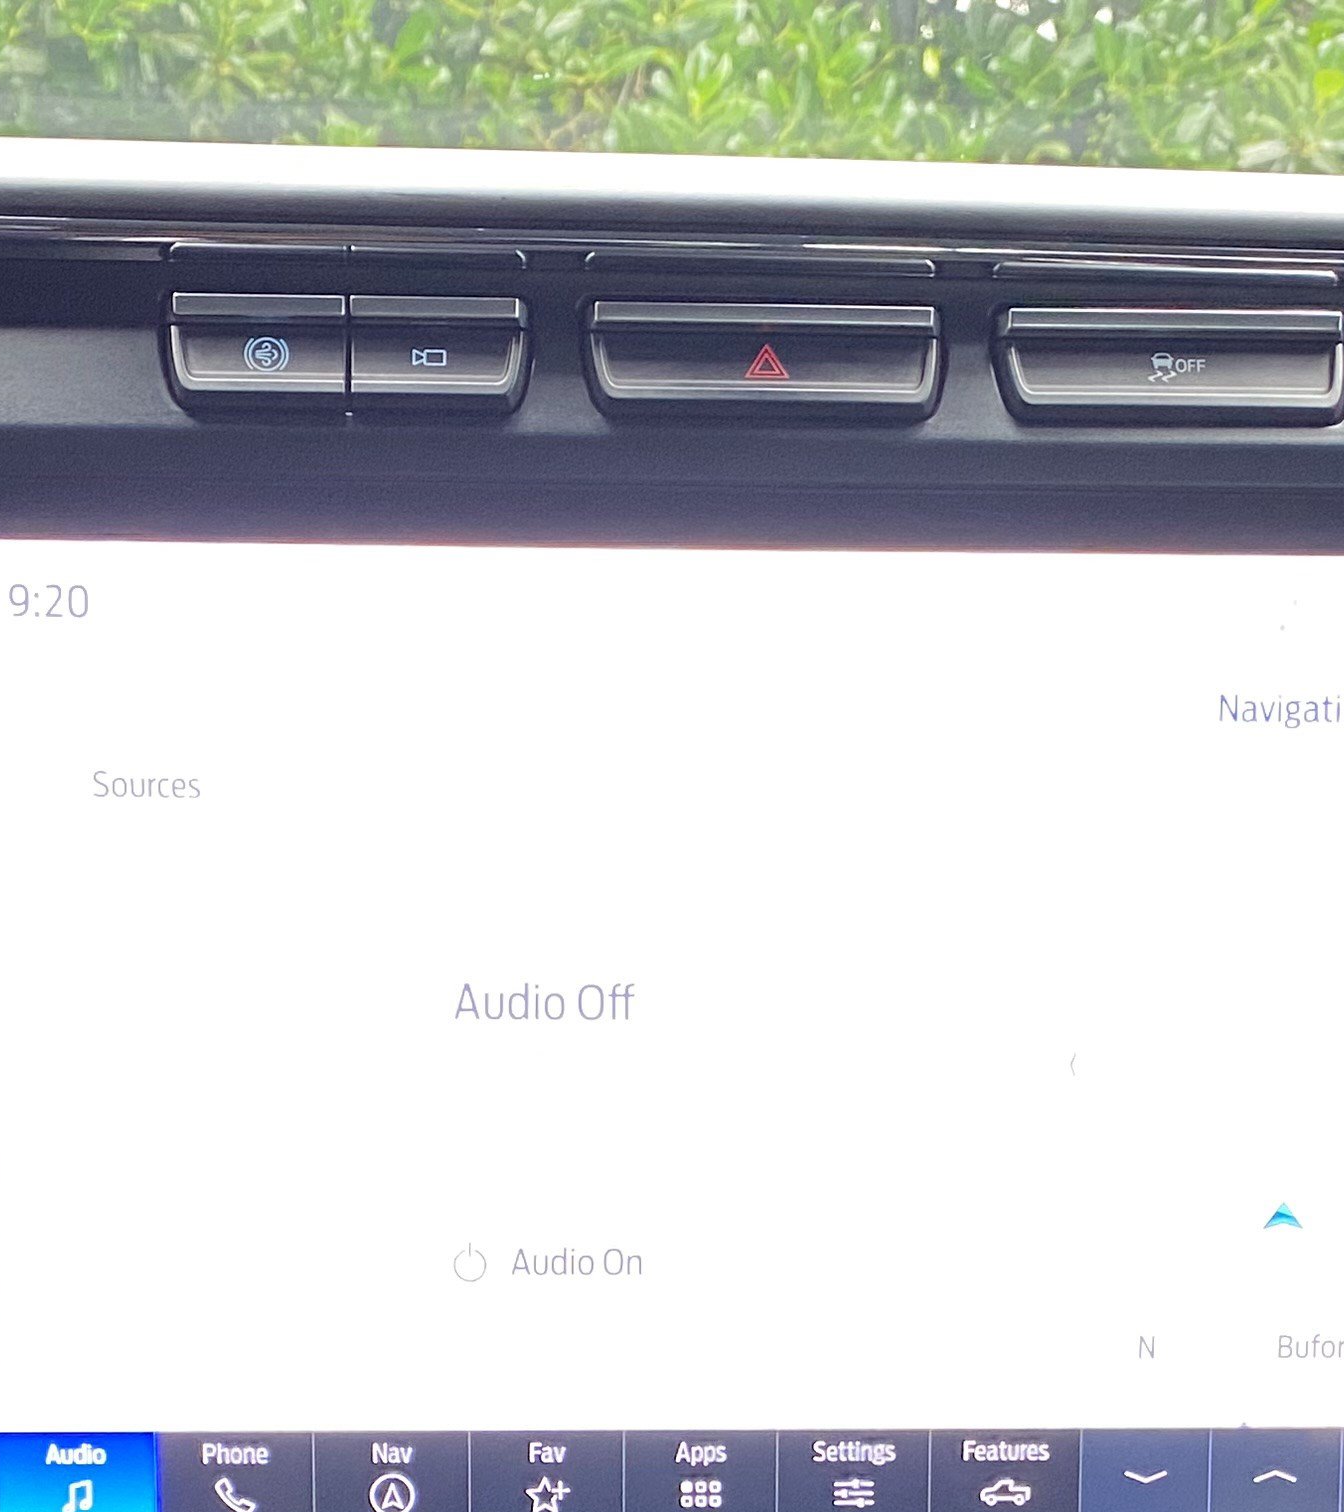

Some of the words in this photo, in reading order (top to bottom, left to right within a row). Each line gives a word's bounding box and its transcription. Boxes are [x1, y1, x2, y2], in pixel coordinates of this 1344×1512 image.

[1174, 357, 1207, 374] OFF
[8, 583, 89, 619] 9:20
[92, 770, 201, 799] Sources
[454, 983, 565, 1021] Audio
[577, 983, 636, 1021] Off
[511, 1246, 595, 1276] Audio
[603, 1247, 643, 1276] On
[1138, 1335, 1156, 1360] N
[45, 1442, 107, 1465] Audio
[202, 1442, 269, 1465] Phone
[372, 1442, 413, 1464] Nav
[528, 1441, 566, 1464] Fav
[675, 1440, 728, 1467] Apps
[812, 1440, 897, 1465] Settings
[962, 1439, 1051, 1462] Features
